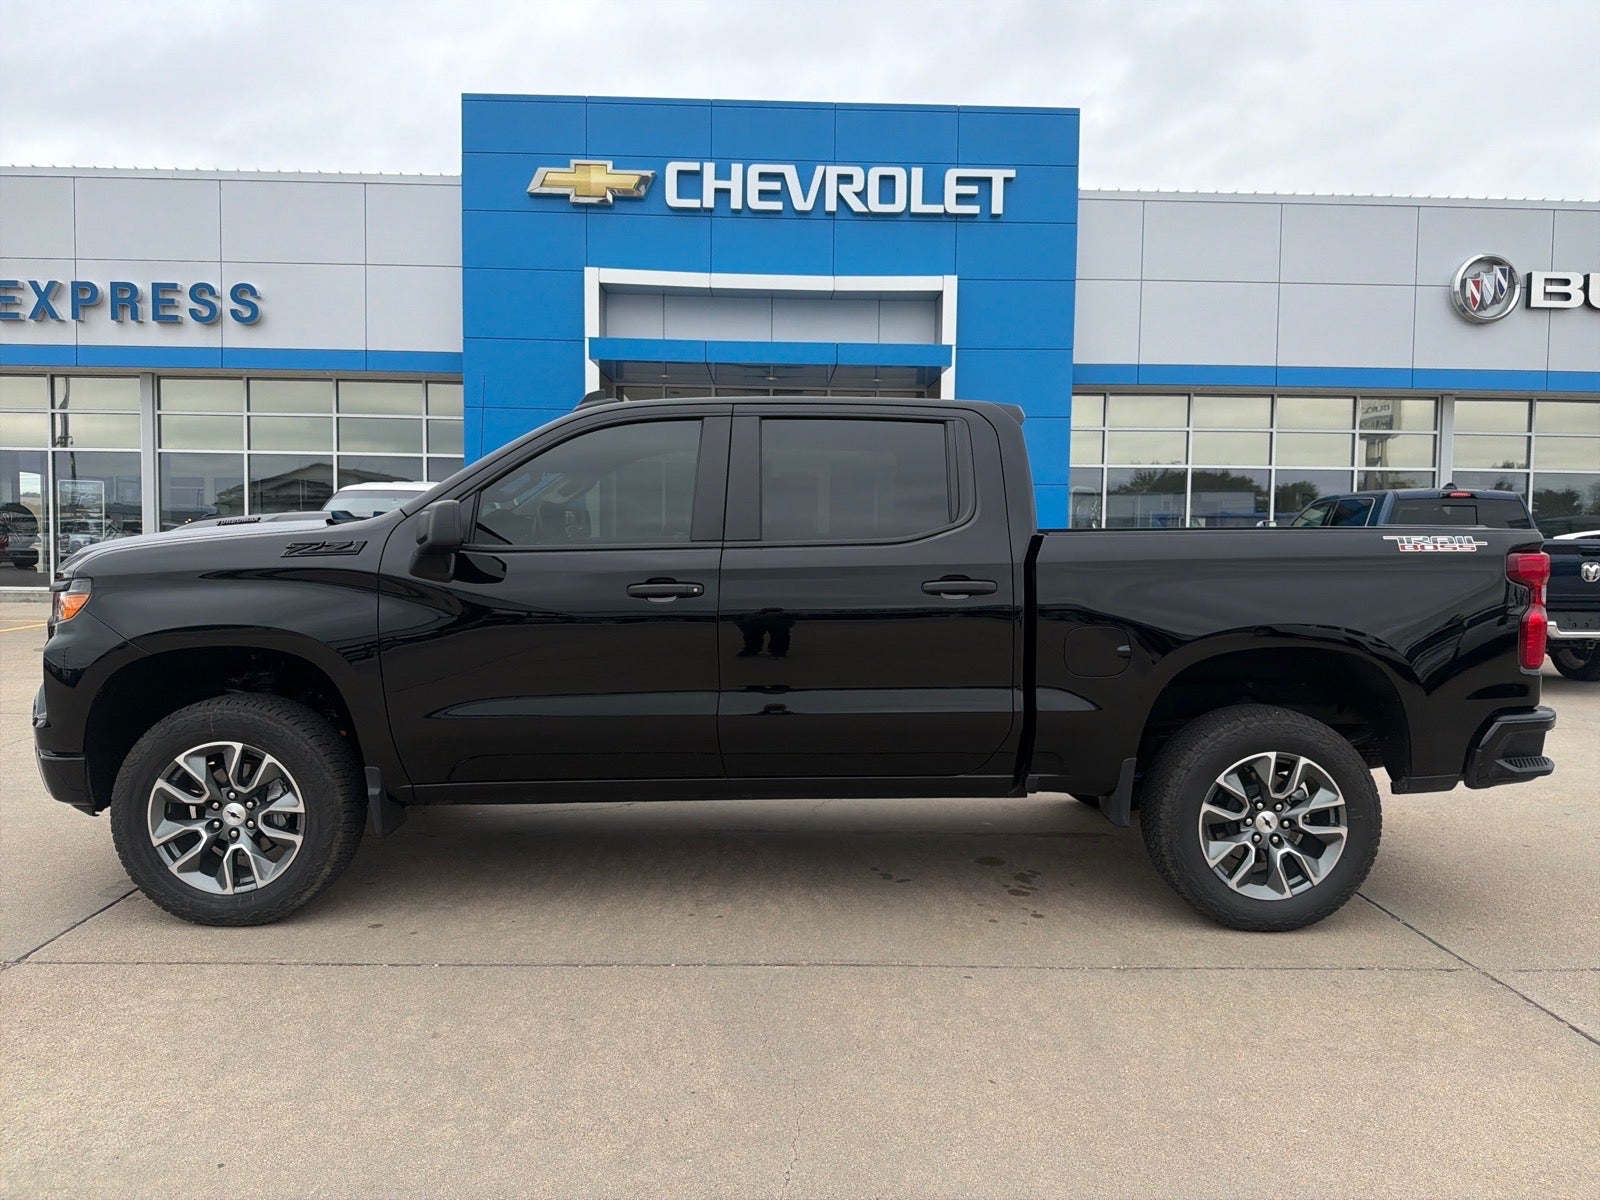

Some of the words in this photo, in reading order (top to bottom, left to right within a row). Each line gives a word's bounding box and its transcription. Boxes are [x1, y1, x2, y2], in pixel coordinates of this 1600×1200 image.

[665, 161, 1017, 217] CHEVROLET
[0, 279, 263, 325] EXPRESS
[1382, 535, 1488, 545] TRAIL
[1399, 544, 1477, 552] BOSS
